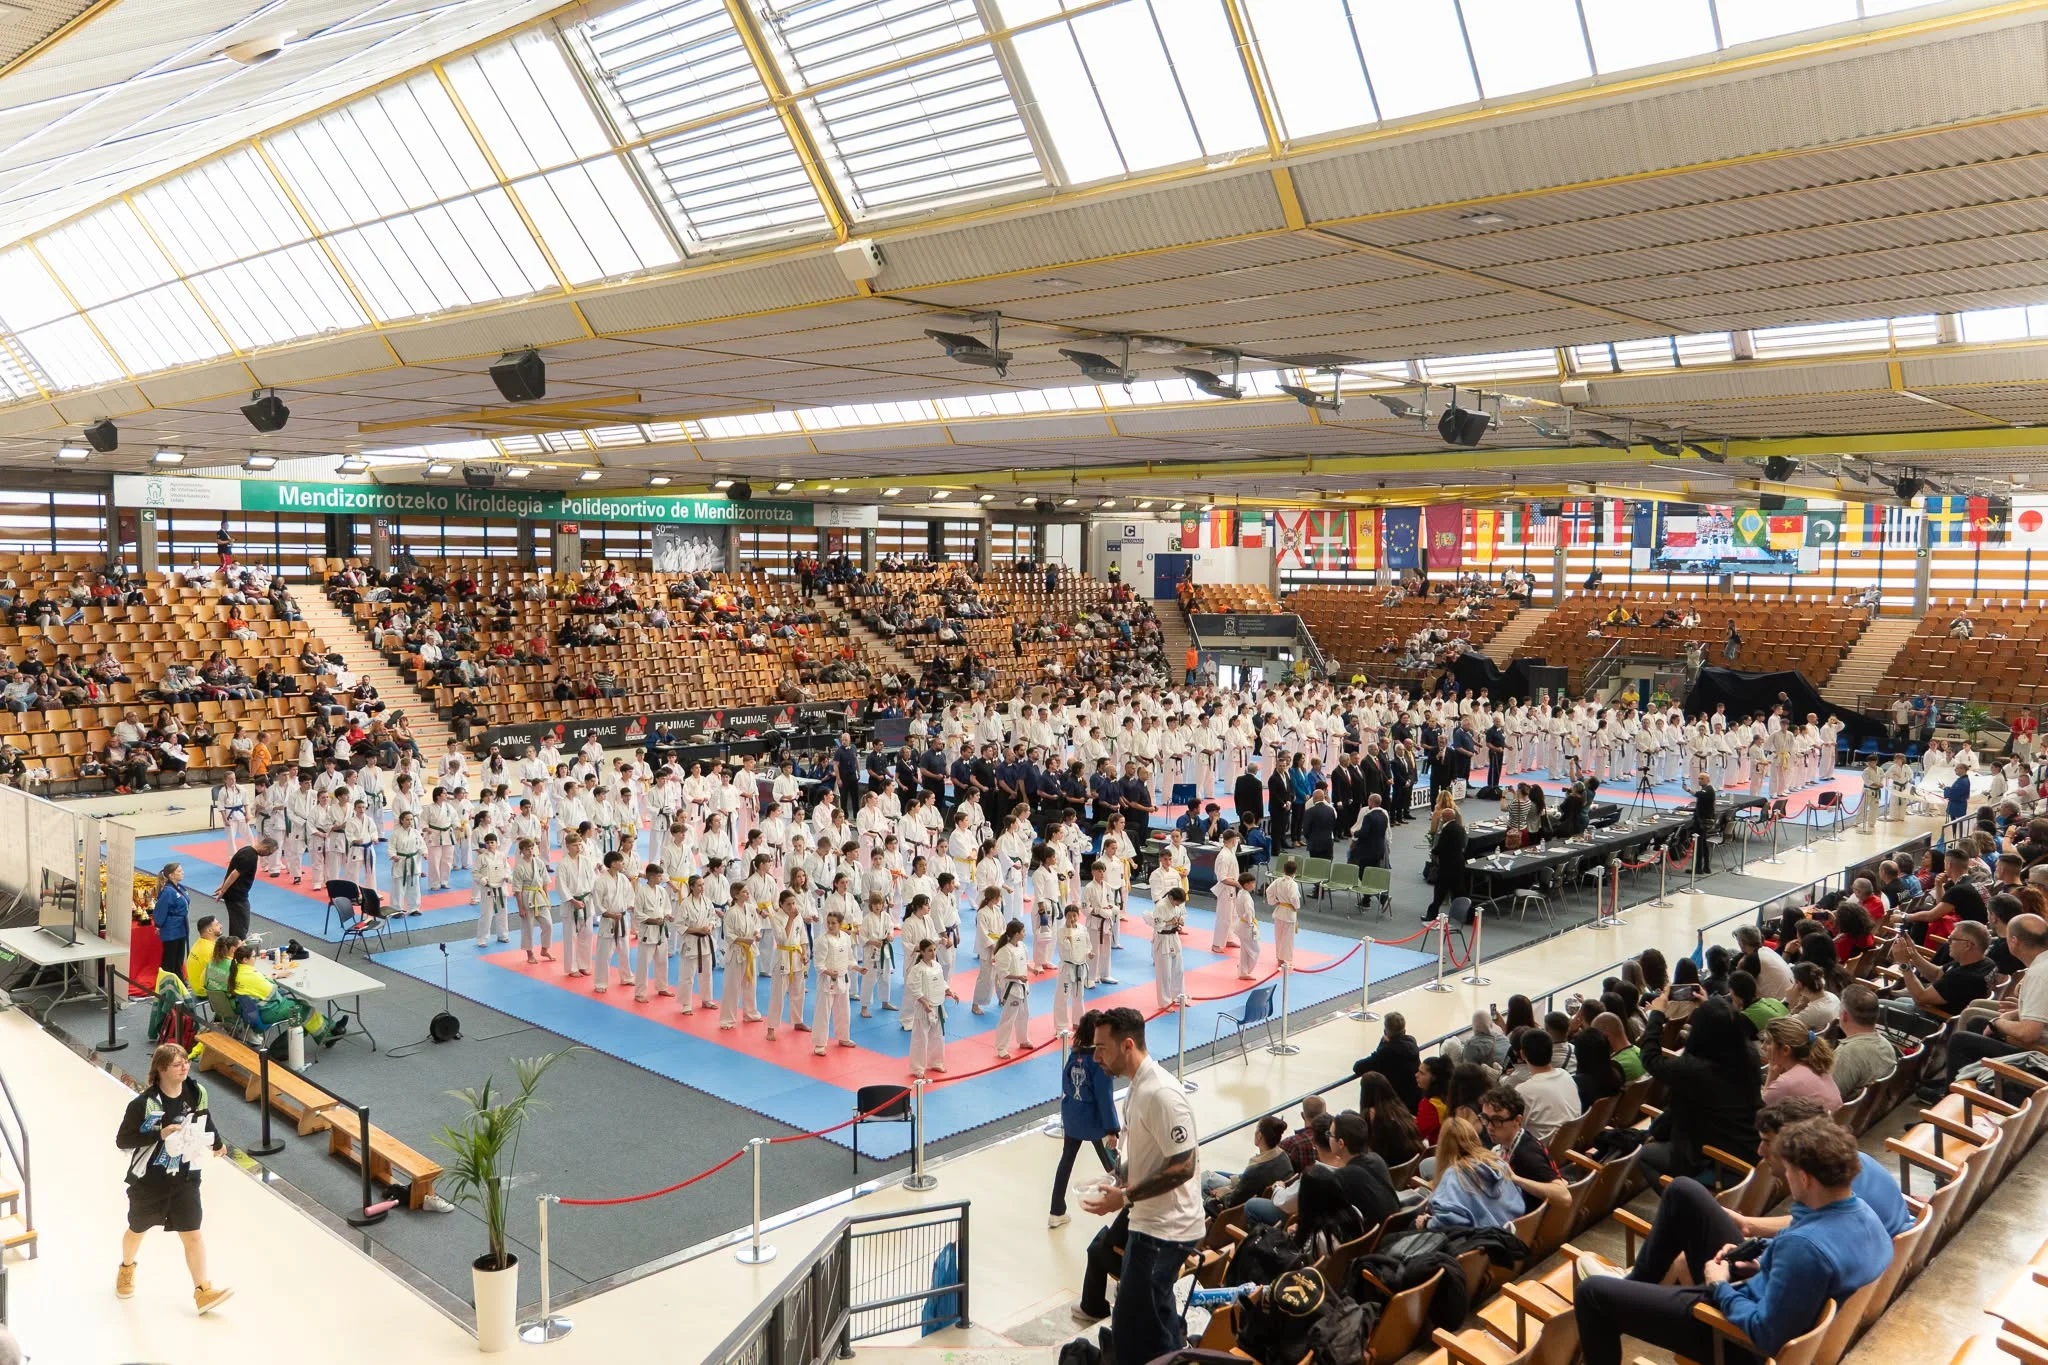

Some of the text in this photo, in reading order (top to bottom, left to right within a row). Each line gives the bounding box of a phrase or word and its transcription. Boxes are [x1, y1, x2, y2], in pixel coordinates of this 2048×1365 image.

[279, 485, 448, 510] Mendizorrotzeko
[455, 492, 543, 517] Kiroldegia
[561, 498, 666, 519] Polideportivo
[671, 501, 688, 518] de
[694, 502, 793, 520] Mendizorrotza
[656, 524, 666, 537] 50
[1125, 526, 1135, 536] C
[730, 714, 767, 726] FUJIMAE
